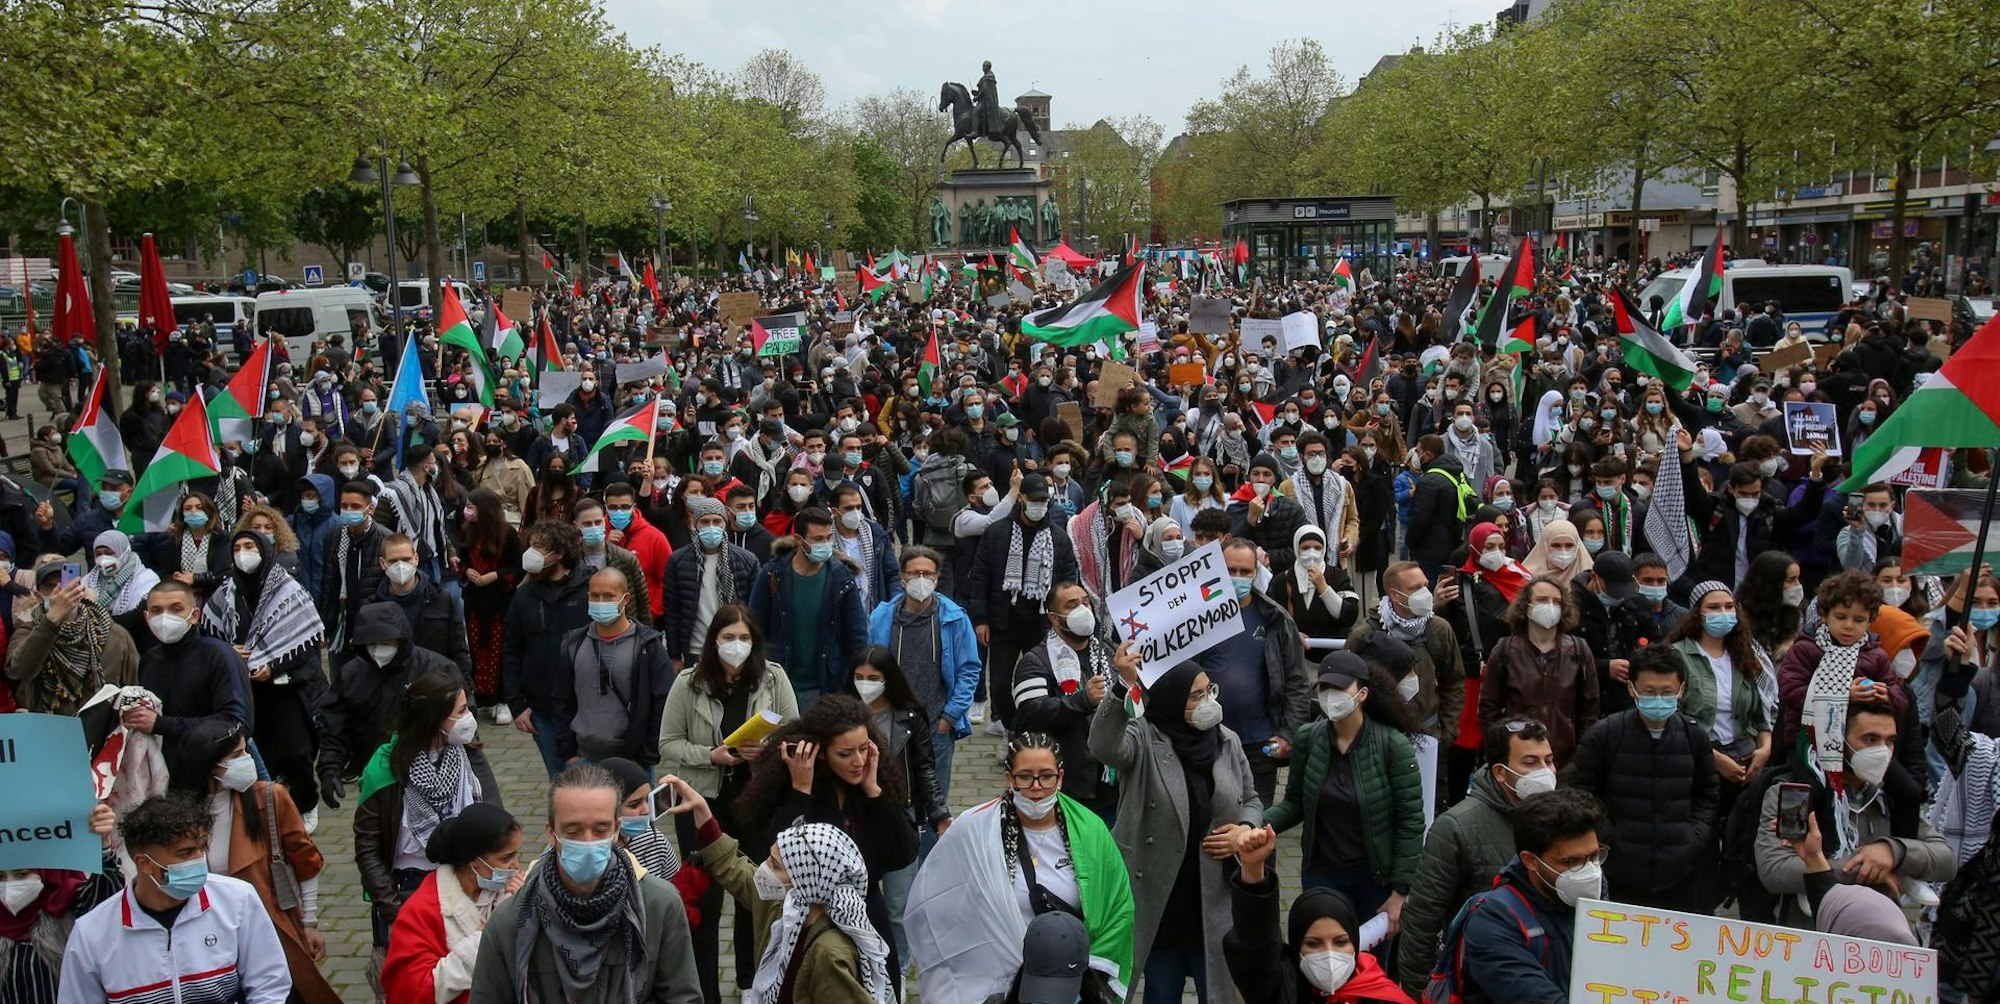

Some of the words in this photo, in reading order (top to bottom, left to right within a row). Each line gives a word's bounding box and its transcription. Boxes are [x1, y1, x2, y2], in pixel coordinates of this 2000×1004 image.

[771, 328, 796, 341] FREE
[1891, 471, 1937, 486] PALESTINE
[1139, 552, 1212, 607] STOPPT
[1167, 592, 1188, 610] DEN
[1586, 909, 1692, 951] IT'S
[1717, 924, 1802, 961] NOT
[1814, 938, 1931, 979] ABOUT
[1585, 982, 1690, 1004] IT'
